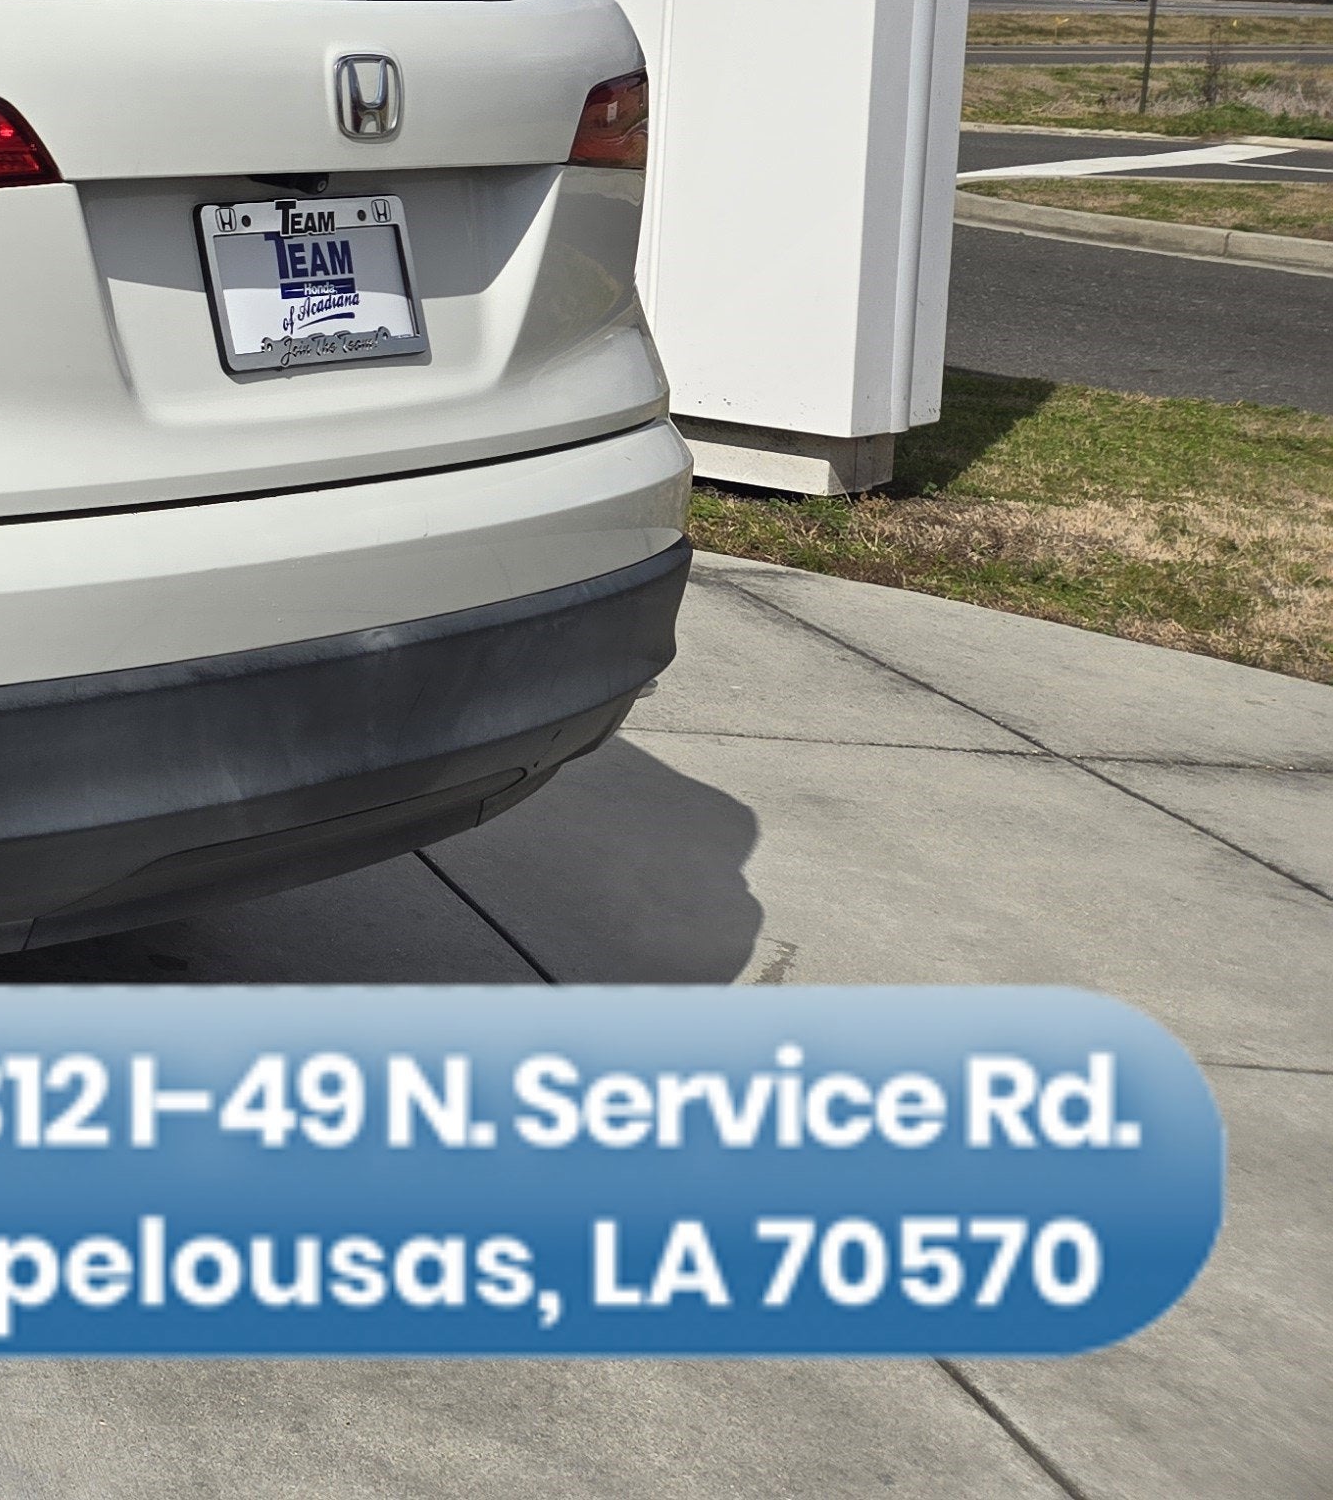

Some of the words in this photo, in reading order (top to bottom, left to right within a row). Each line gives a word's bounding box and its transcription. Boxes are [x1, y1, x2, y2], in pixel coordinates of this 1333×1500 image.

[274, 200, 336, 235] TEAM
[303, 282, 336, 295] Honda
[282, 305, 296, 335] of
[297, 292, 360, 322] Acadiana
[280, 335, 312, 367] Join
